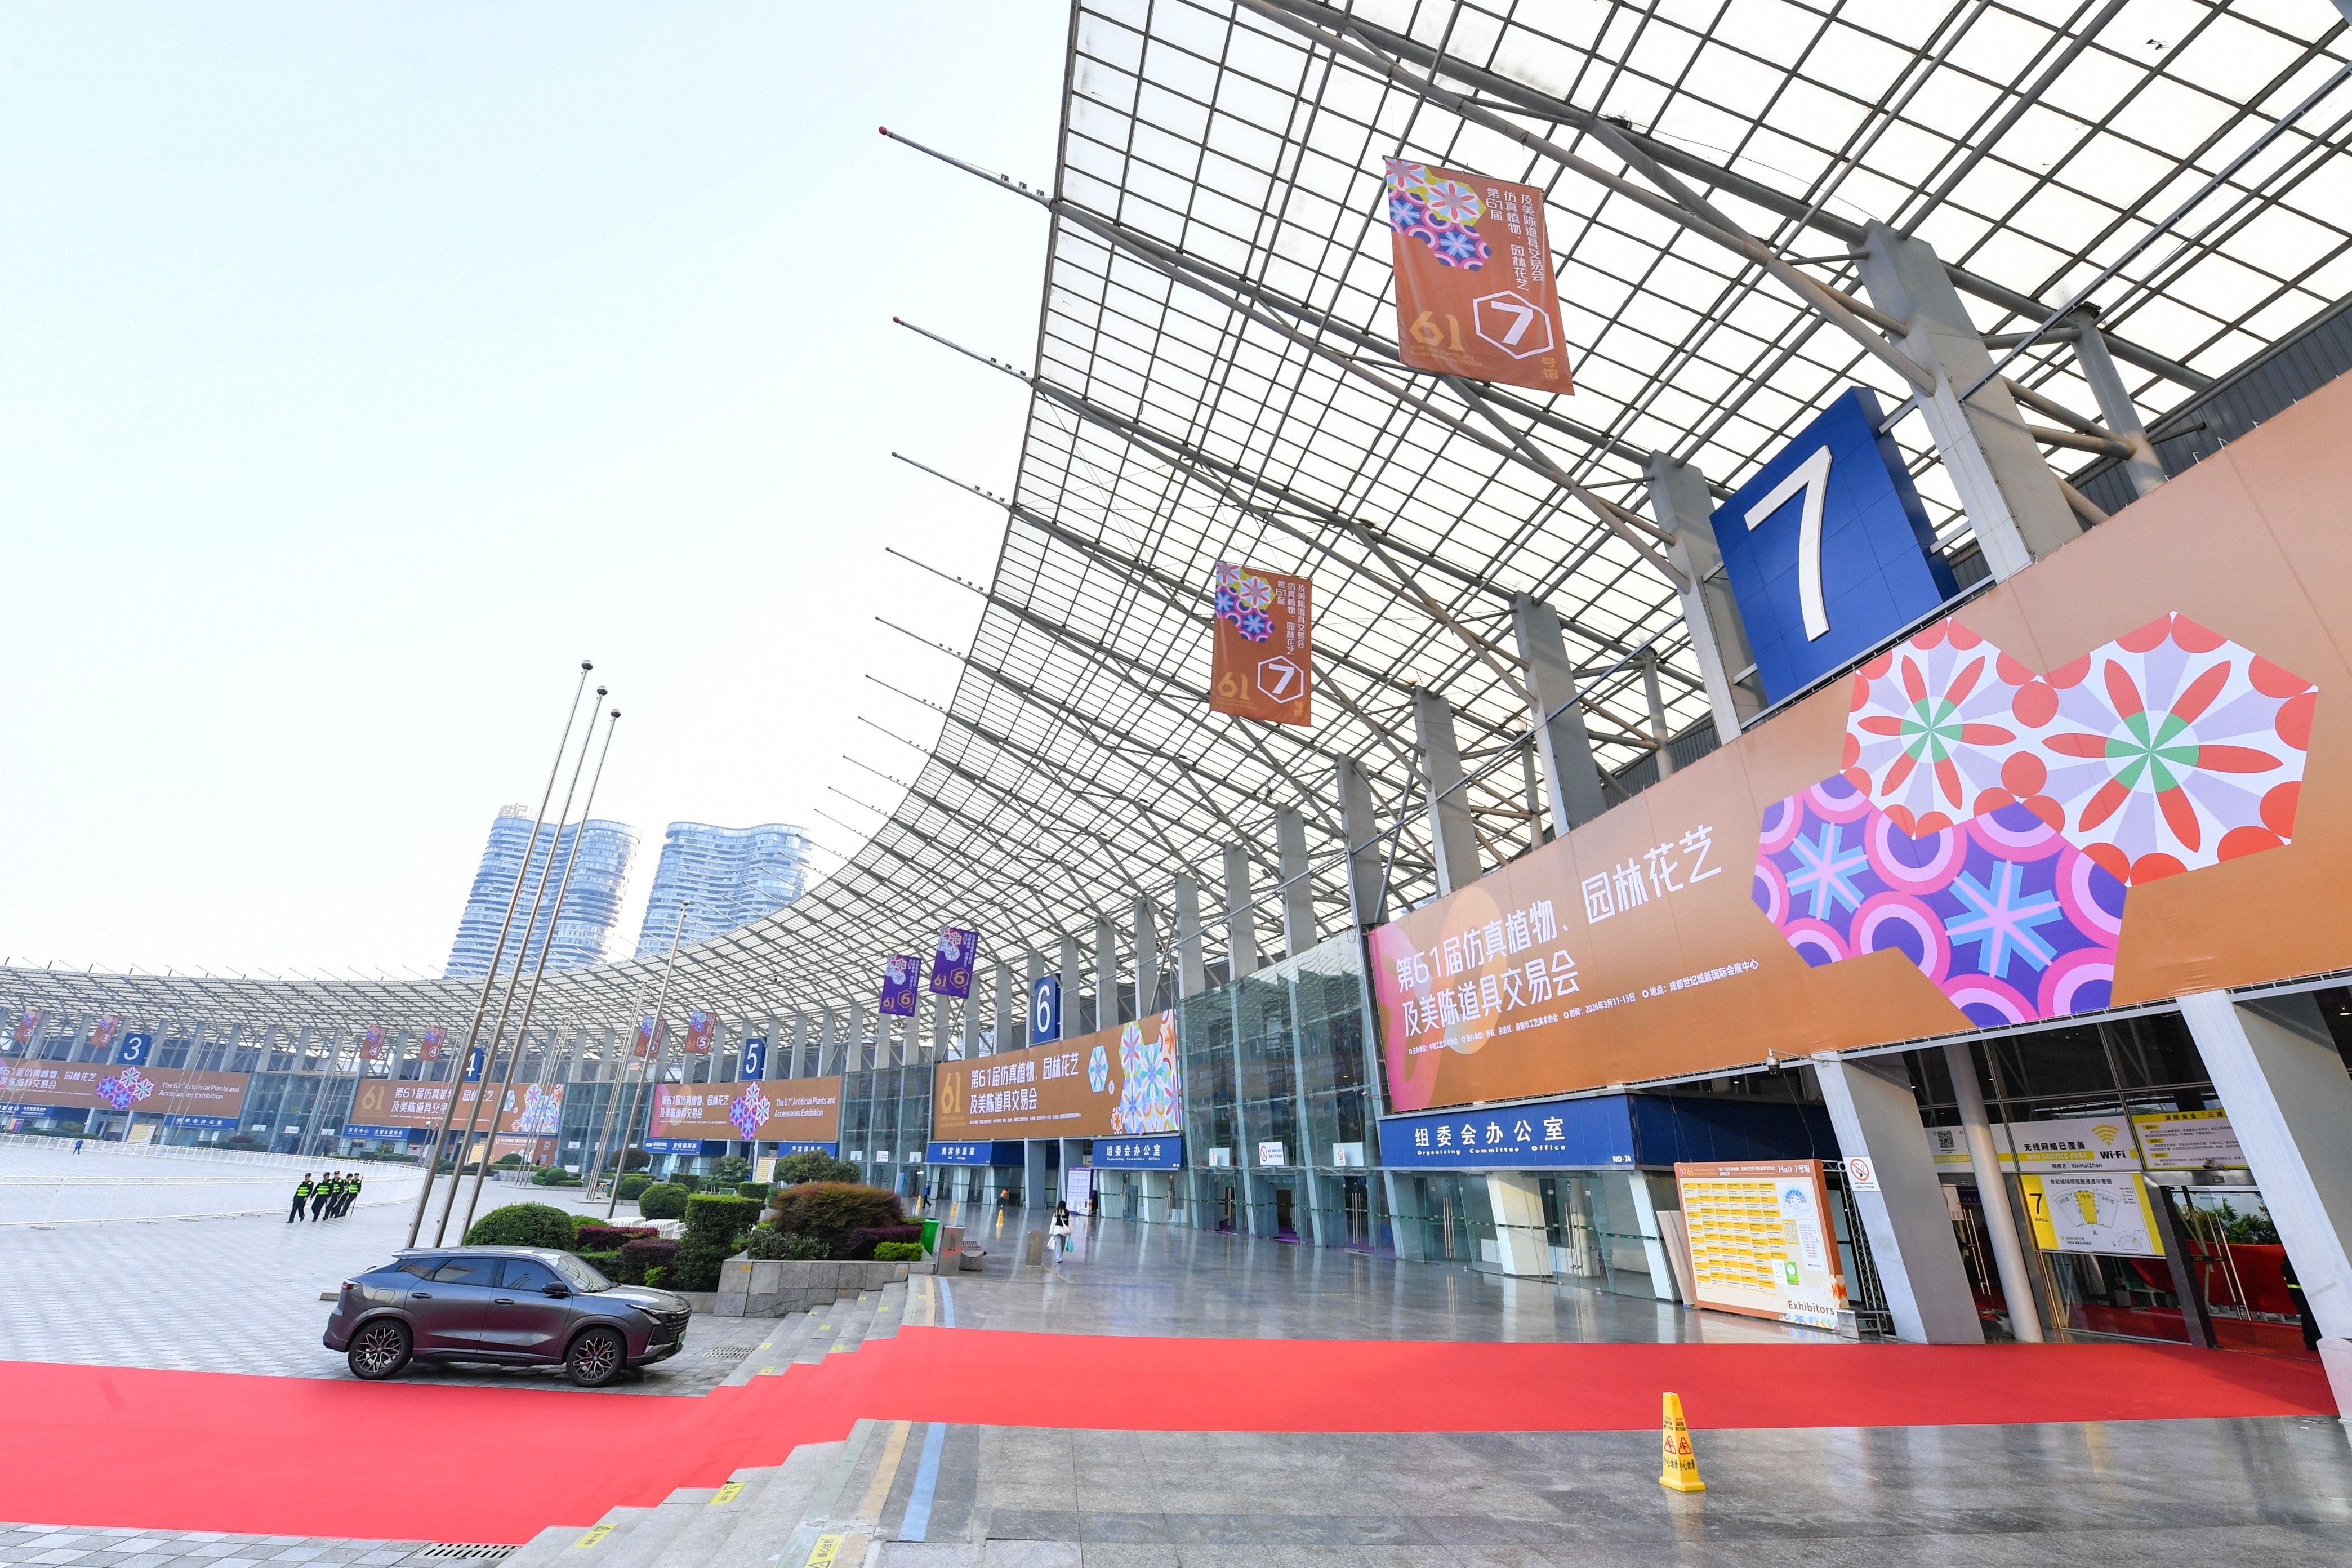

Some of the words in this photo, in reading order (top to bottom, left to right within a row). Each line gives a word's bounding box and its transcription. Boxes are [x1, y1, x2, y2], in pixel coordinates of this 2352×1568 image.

[1486, 187, 1503, 221] 第61届
[1520, 194, 1544, 282] 及美陈道具交易会
[1409, 310, 1465, 351] 61
[1491, 300, 1534, 346] 7
[1744, 445, 1832, 642] 7
[1276, 581, 1286, 605] 第61届
[1297, 583, 1306, 649] 及美陈道具交易会
[1217, 671, 1249, 701] 61
[1269, 663, 1295, 694] 7
[934, 974, 947, 987] 61
[954, 971, 964, 985] 6
[883, 997, 894, 1008] 61
[901, 993, 910, 1005] 6
[1402, 948, 1580, 1037] 及美陈道具交易会
[1036, 985, 1051, 1033] 6
[124, 1037, 142, 1061] 3
[700, 1038, 707, 1046] 5
[746, 1043, 759, 1074] 5
[362, 1085, 385, 1110] 61
[941, 1072, 961, 1113] 61
[970, 1087, 1037, 1115] 及美陈道具交易会
[660, 1107, 703, 1119] 及美陈道具交易会
[801, 1108, 824, 1117] Exhibition
[1415, 1116, 1565, 1147] 组委会办公室
[1106, 1144, 1161, 1156] 组委会办公室
[2024, 1141, 2086, 1151] 无线网络已覆盖
[2099, 1150, 2126, 1159] Wi-Fi
[1687, 1166, 1694, 1177] 61
[2029, 1193, 2042, 1214] 7
[1788, 1300, 1835, 1315] Exhibitors
